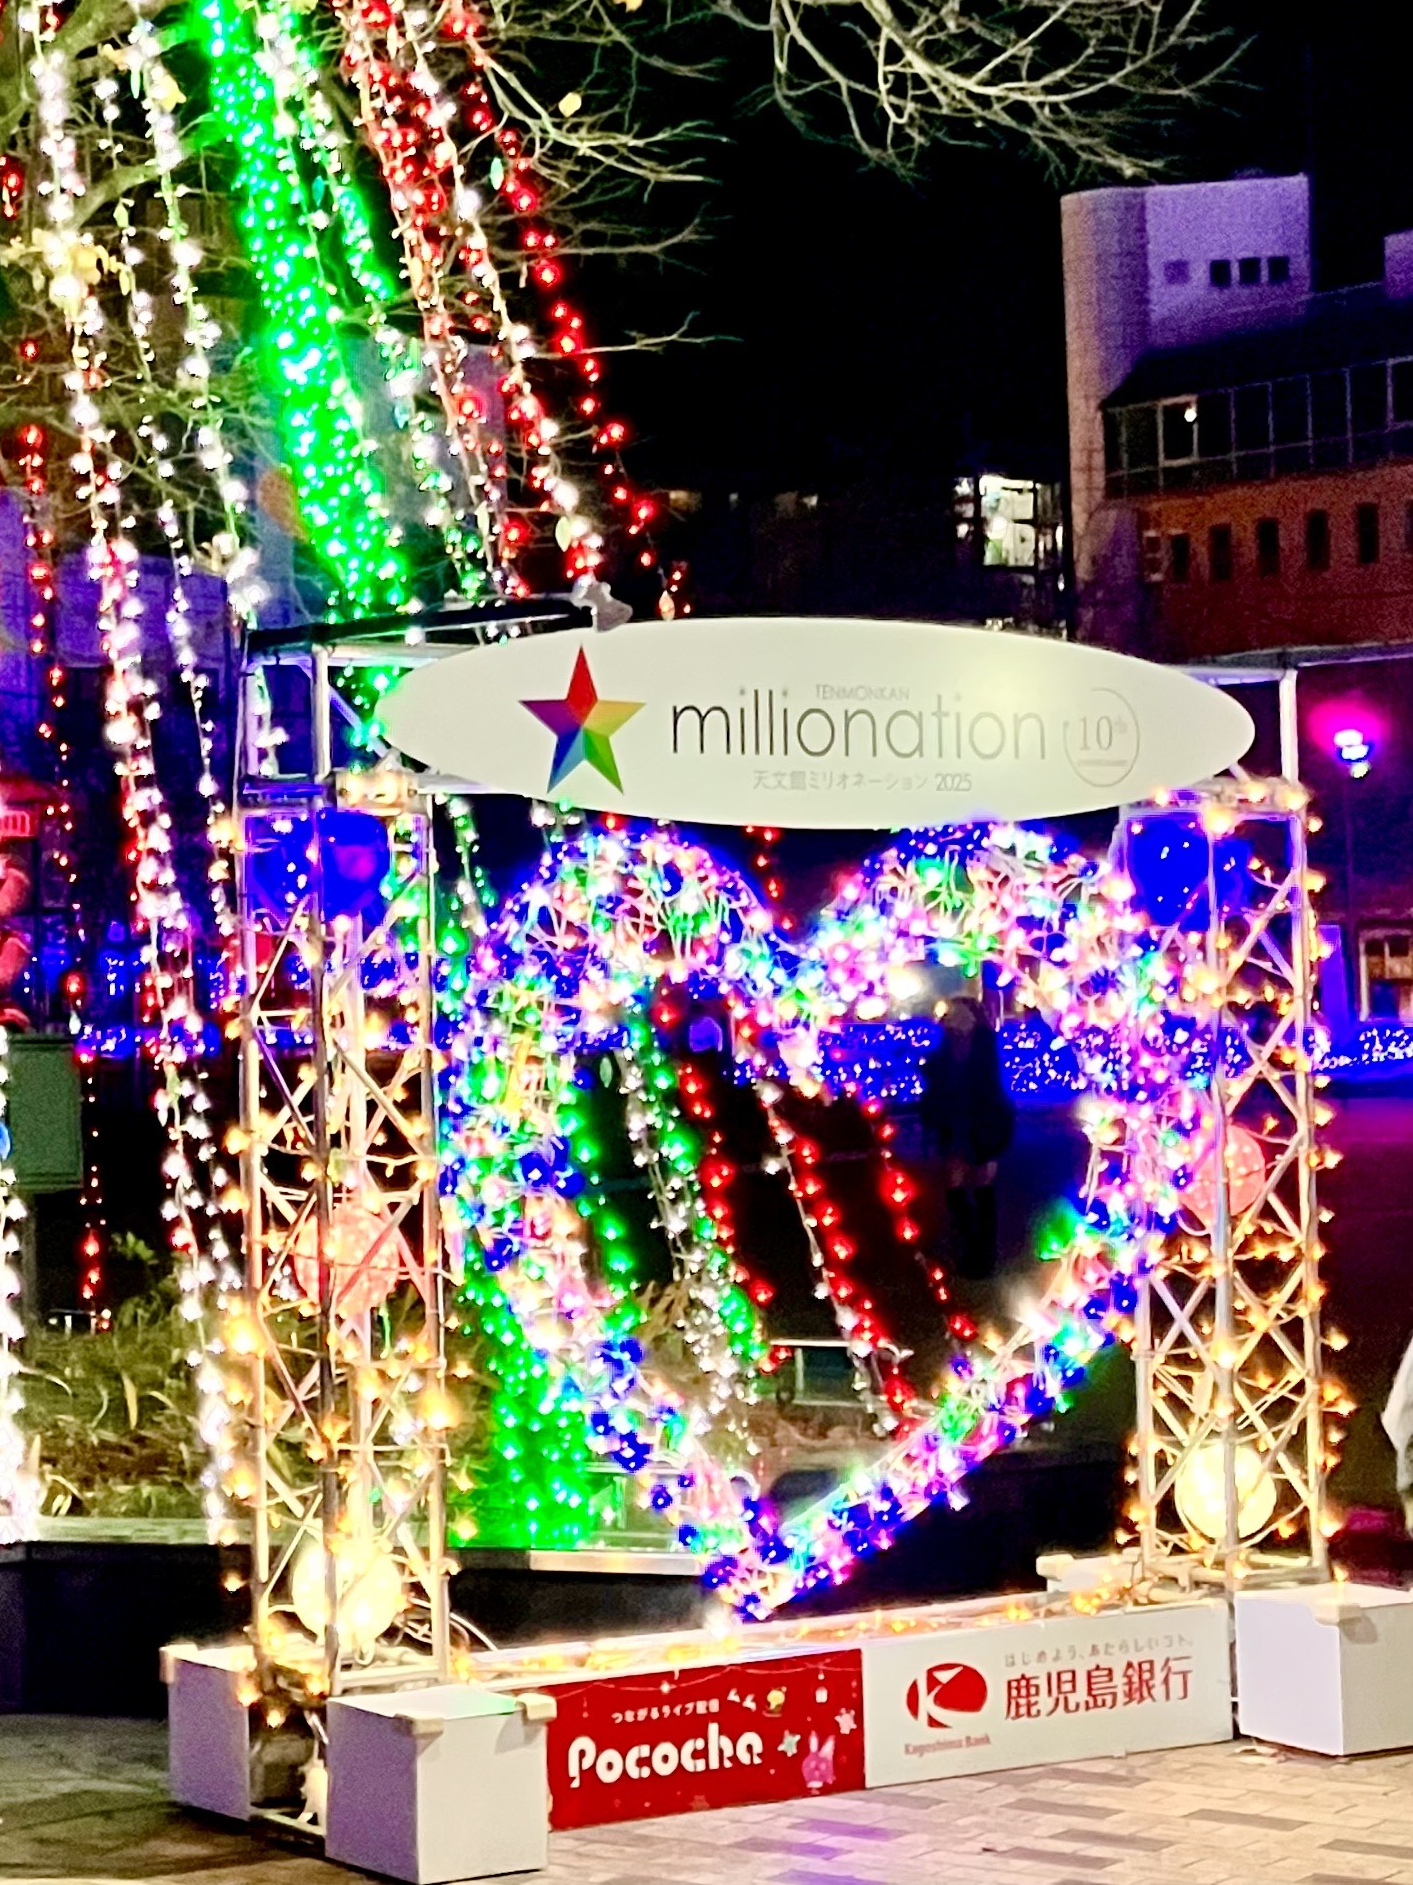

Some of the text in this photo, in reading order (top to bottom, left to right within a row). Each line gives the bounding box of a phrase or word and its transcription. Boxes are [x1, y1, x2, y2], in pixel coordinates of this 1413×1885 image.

[672, 688, 1046, 760] millionation
[935, 773, 973, 793] 2025
[1005, 1656, 1194, 1721] 鹿児島銀行
[568, 1721, 764, 1788] Pococha
